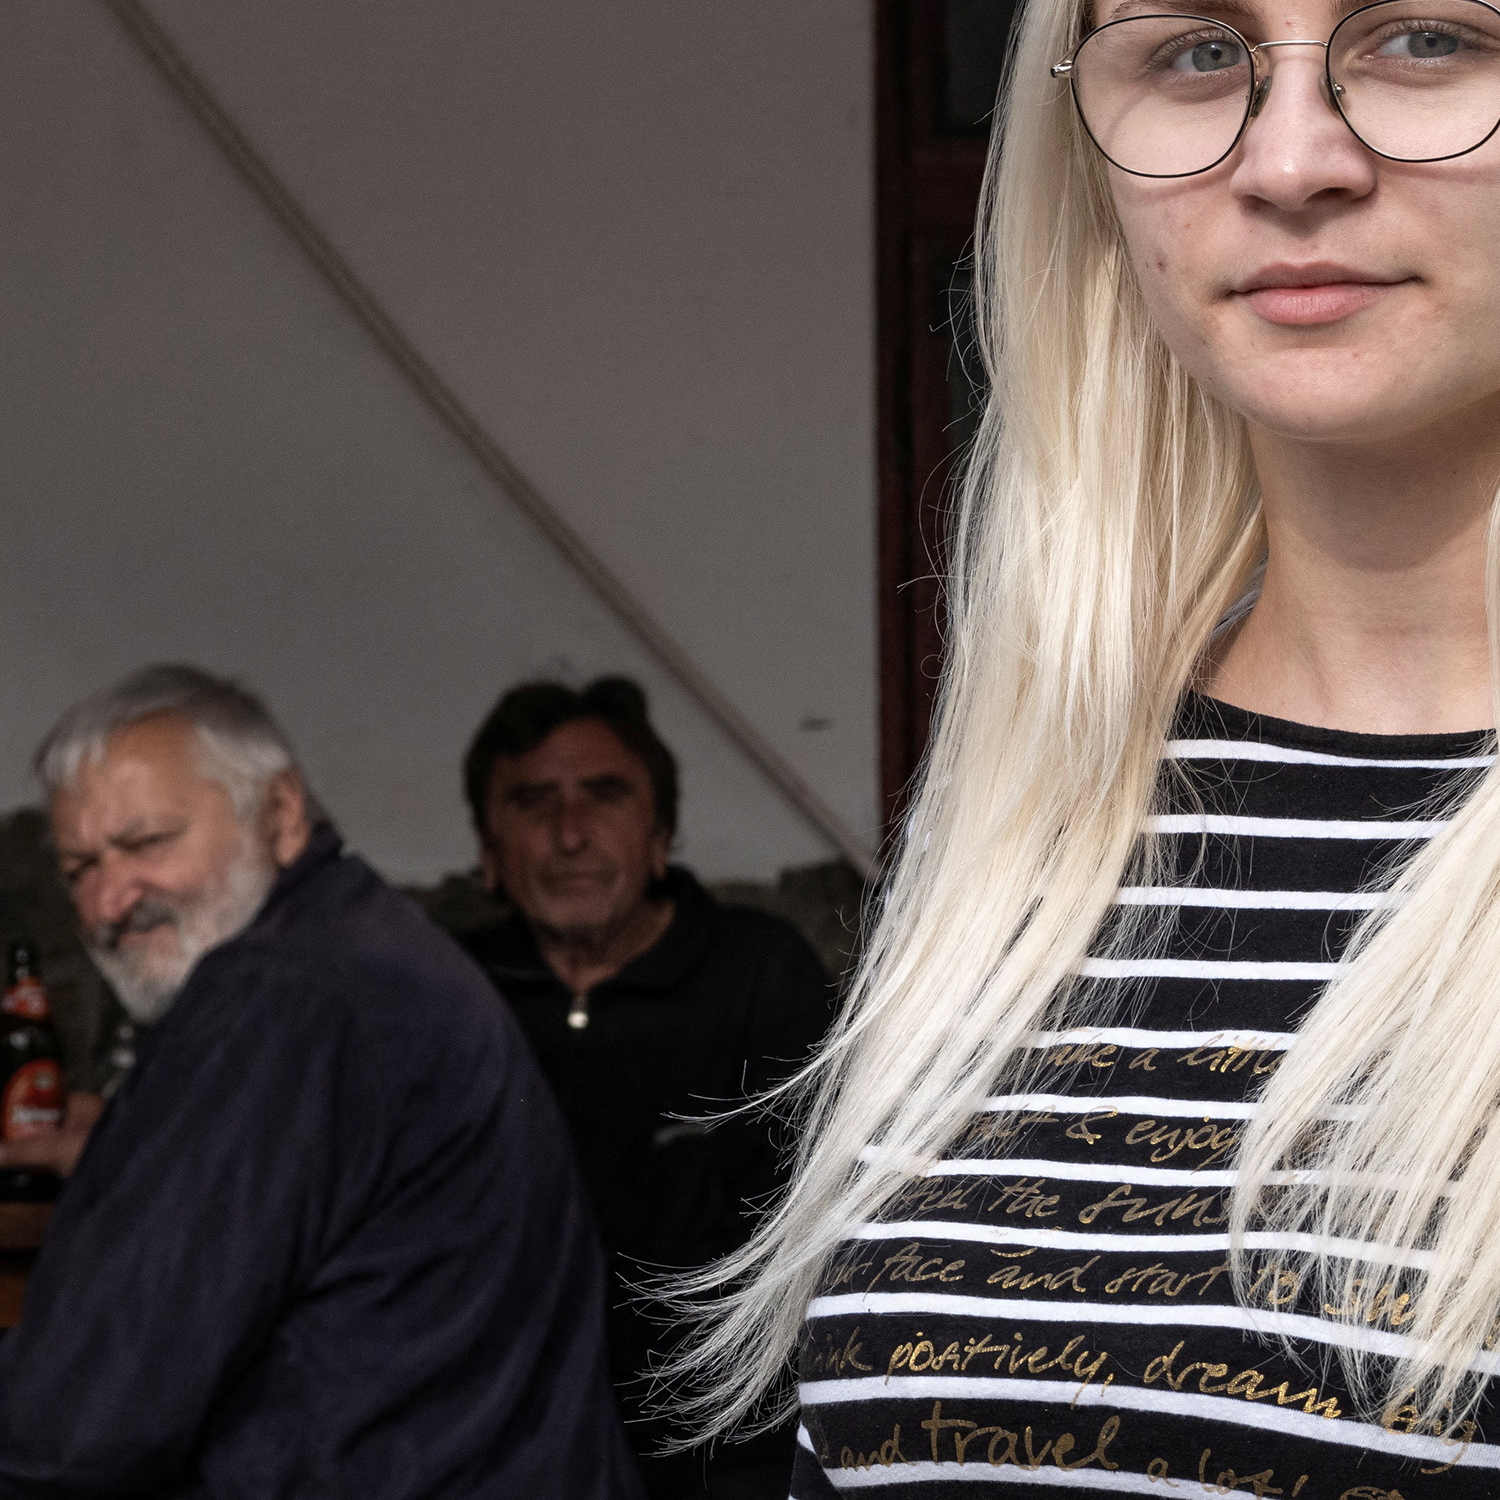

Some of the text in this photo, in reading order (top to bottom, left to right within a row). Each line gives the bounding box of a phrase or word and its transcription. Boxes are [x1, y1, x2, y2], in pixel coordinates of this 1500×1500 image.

[1128, 1048, 1160, 1072] a
[1065, 1105, 1118, 1145] &
[1125, 1116, 1237, 1175] enjoy
[988, 1176, 1058, 1218] the
[863, 1242, 966, 1302] face
[986, 1255, 1100, 1293] and
[1104, 1256, 1231, 1297] start
[808, 1326, 873, 1378] ink
[885, 1331, 1113, 1408] positively,
[1144, 1339, 1342, 1420] dream
[840, 1422, 906, 1473] and
[921, 1401, 1118, 1471] travel
[1146, 1456, 1179, 1488] a
